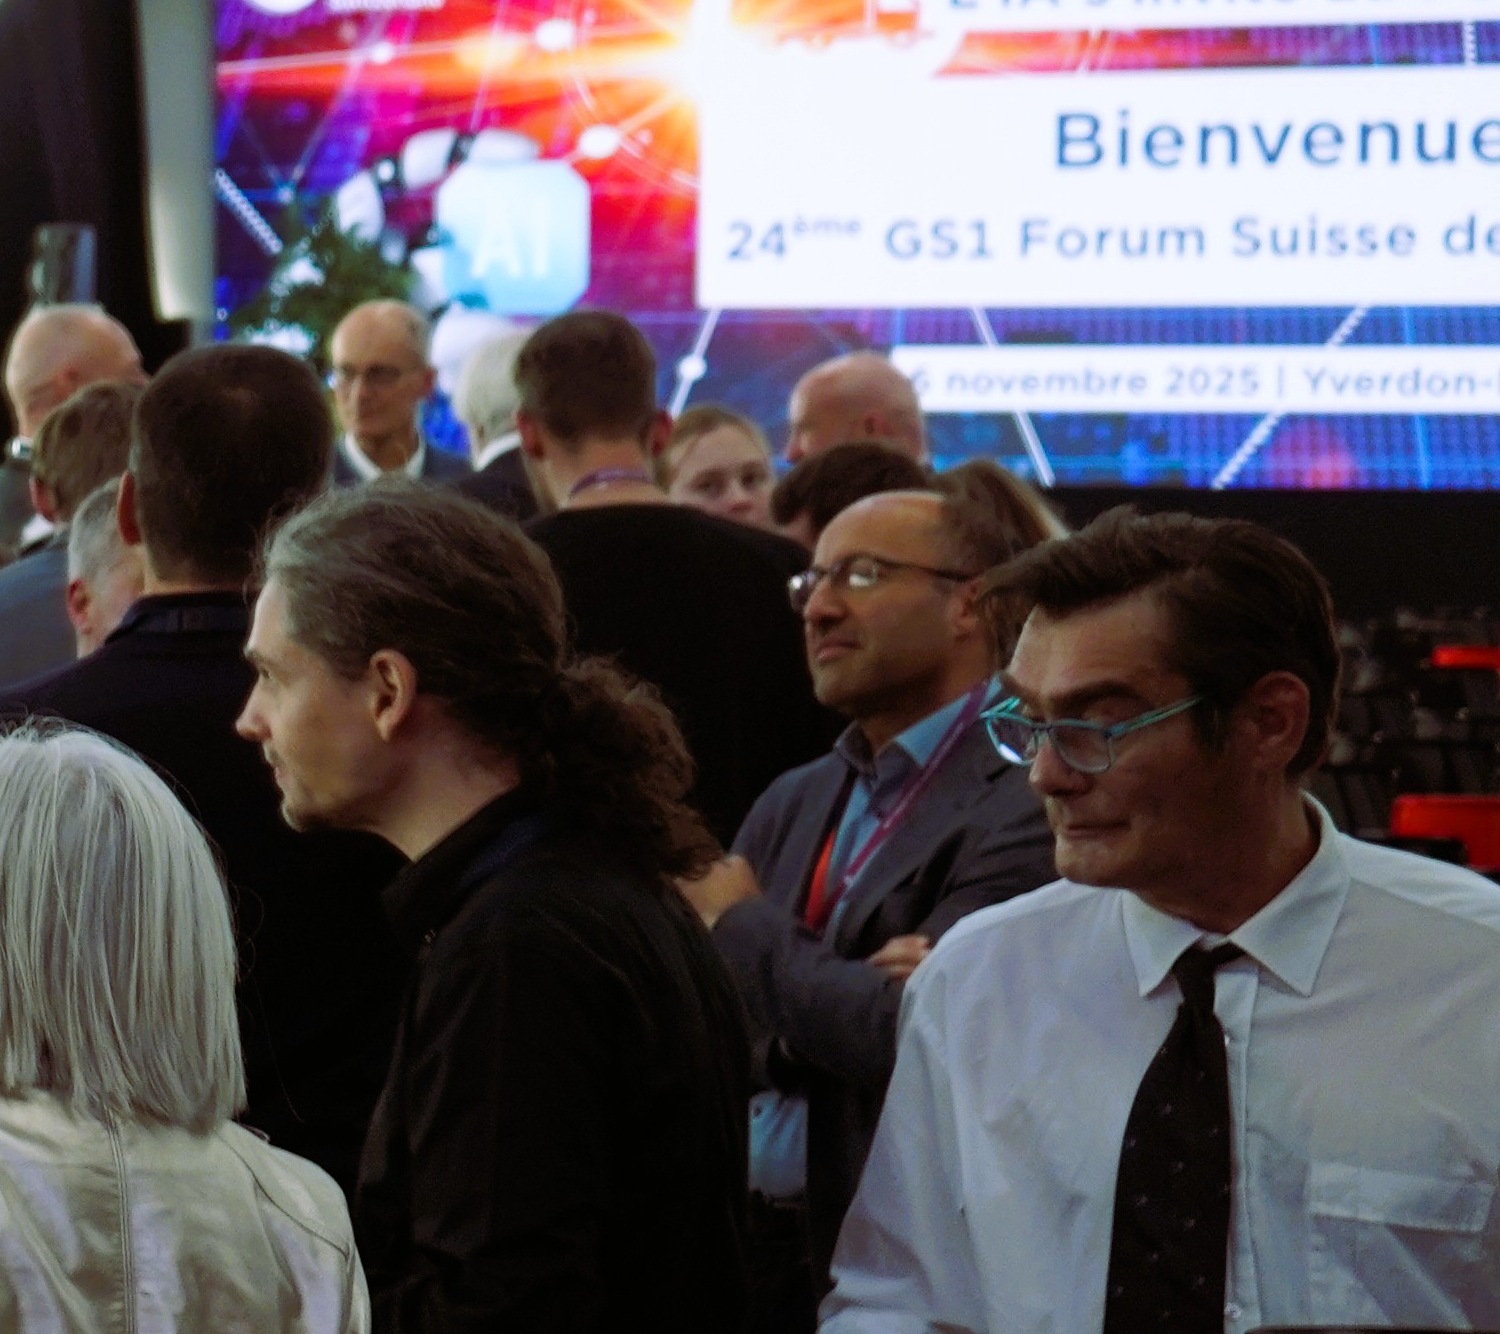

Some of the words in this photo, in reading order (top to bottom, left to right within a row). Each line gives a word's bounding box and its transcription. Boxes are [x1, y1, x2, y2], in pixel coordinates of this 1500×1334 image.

[1056, 109, 1500, 169] Bienvenue
[884, 218, 992, 260] GS1
[1019, 218, 1205, 258] Forum
[1232, 212, 1416, 257] Suisse
[947, 364, 1147, 396] novembre
[1165, 367, 1259, 396] 2025
